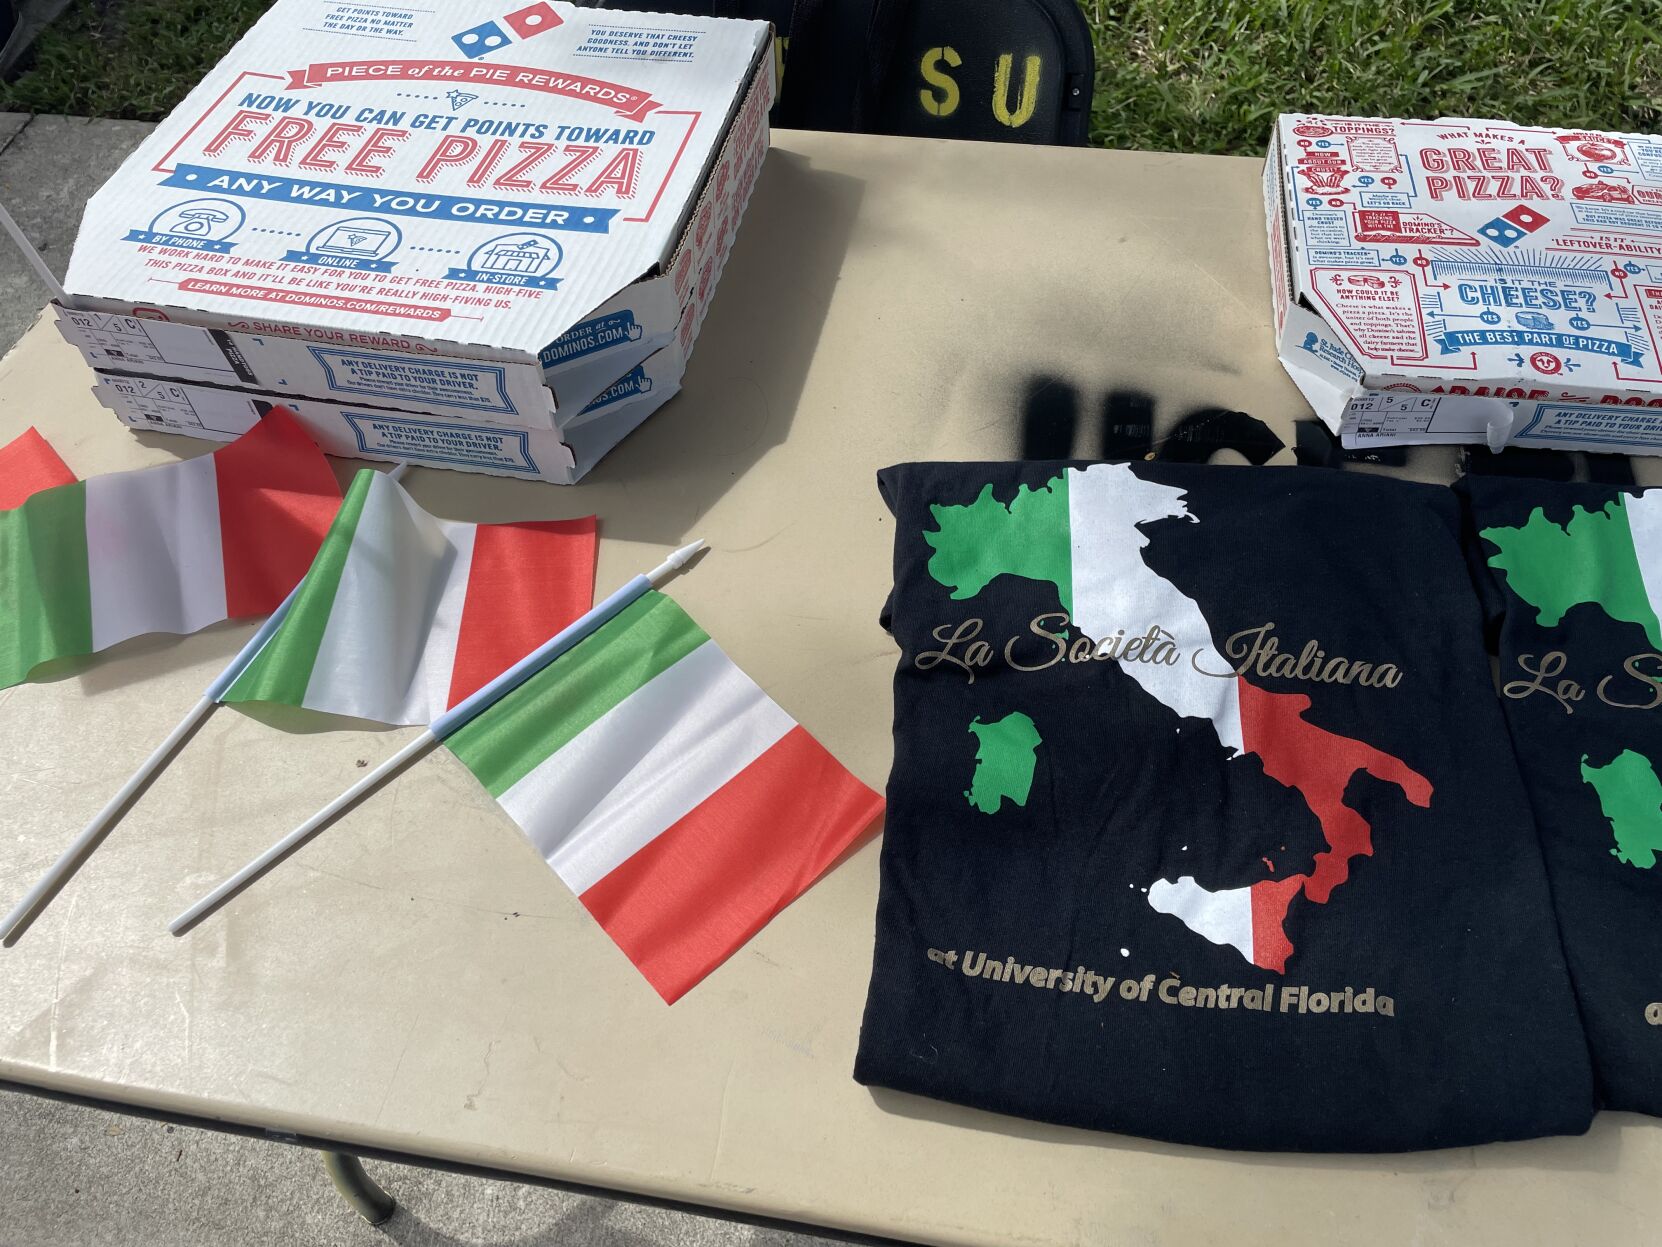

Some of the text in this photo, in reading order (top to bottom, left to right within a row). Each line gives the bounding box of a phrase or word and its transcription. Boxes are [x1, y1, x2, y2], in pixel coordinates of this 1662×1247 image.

[346, 16, 367, 24] PIZZA
[383, 20, 414, 28] MATTER
[352, 8, 380, 17] POINTS
[382, 11, 414, 20] TOWARD
[608, 30, 642, 38] DESERVE
[668, 34, 698, 42] CHEESY
[576, 46, 609, 54] ANYONE
[326, 65, 403, 77] PIECE
[408, 66, 432, 77] of
[432, 66, 464, 77] the
[470, 68, 510, 80] PIE
[238, 92, 656, 146] NOW YOU CAN GET POINTS TOWARD
[1332, 126, 1395, 134] TOPPINGS?
[1436, 132, 1469, 140] WHAT
[1474, 132, 1514, 142] MAKES
[203, 110, 644, 200] FREE PIZZA
[1419, 147, 1556, 174] GREAT
[1425, 176, 1565, 200] PIZZA?
[207, 175, 570, 224] ANY WAY YOU ORDER
[152, 235, 207, 248] BY PHONE
[138, 244, 543, 299] WE WORK HARD TO MAKE IT EASY FOR YOU TO GET FREE PIZZA. HIGH-FIVE
[318, 257, 359, 268] ONLINE
[144, 259, 512, 309] THIS PIZZA BOX AND IT'LL BE LIKE YOU'RE REALLY HIGH-FIVING US.
[476, 272, 528, 284] IN-STORE
[188, 282, 441, 318] LEARN MORE AT DOMINOS.COM/REWARDS
[1458, 284, 1596, 312] CHEESE?
[71, 317, 136, 329] 012 C
[253, 322, 410, 349] SHARE YOUR REWARD
[556, 326, 592, 344] ORDER
[1456, 332, 1618, 354] THE BEST PART OF PIZZA
[543, 327, 624, 362] DOMINOS.COM
[1320, 346, 1346, 364] Research
[341, 359, 360, 367] ANY
[362, 362, 406, 374] DELIVERY
[408, 367, 447, 378] CHARGE
[460, 372, 478, 382] NOT
[115, 384, 136, 394] 012
[375, 372, 398, 380] PAID
[412, 376, 438, 385] YOUR
[440, 380, 478, 390] DRIVER.
[1351, 402, 1374, 410] 012
[1421, 398, 1432, 406] C
[1576, 413, 1620, 421] DELIVERY
[1622, 416, 1658, 424] CHARGE
[392, 424, 435, 436] DELIVERY
[436, 431, 472, 440] CHARGE
[486, 436, 504, 444] NOT
[405, 434, 426, 442] PAID
[440, 438, 464, 447] YOUR
[466, 441, 502, 452] DRIVER.
[914, 612, 1403, 689] La Società Italiana
[1504, 651, 1586, 714] La
[926, 948, 1396, 1017] at University of Central Florida
